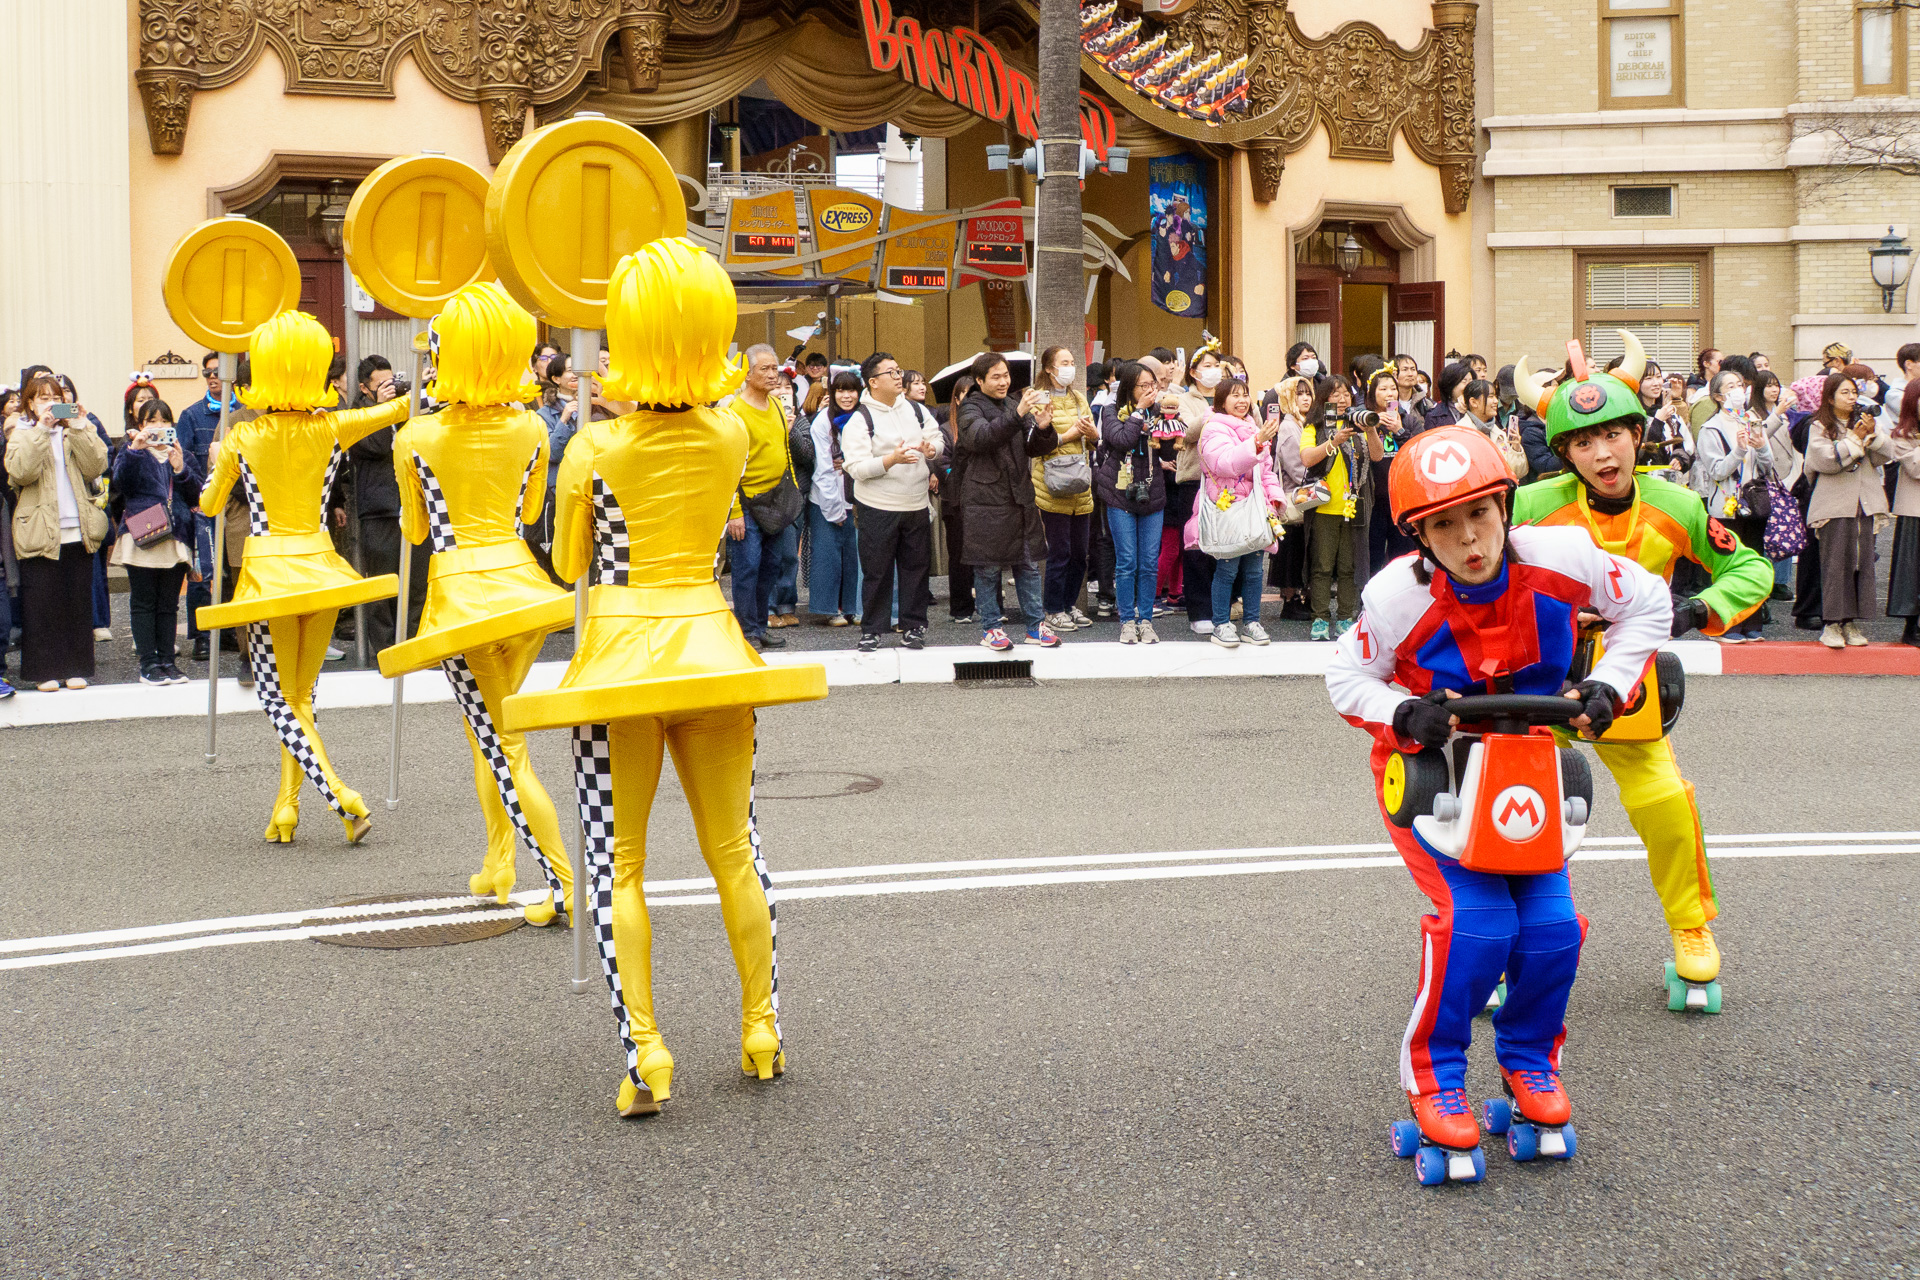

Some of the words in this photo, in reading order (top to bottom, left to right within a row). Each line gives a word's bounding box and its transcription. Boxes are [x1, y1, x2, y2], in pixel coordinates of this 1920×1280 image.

[1624, 32, 1656, 40] EDITOR
[1617, 61, 1665, 71] DEBORAH
[1615, 71, 1667, 81] BRINKLEY
[860, 0, 1117, 178] BACKDRP
[750, 206, 778, 218] SINGLES
[739, 219, 790, 229] シングルライダー
[825, 210, 869, 229] EXPRESS
[976, 220, 1018, 232] BACKDROP
[896, 236, 950, 249] HOLLYWOOD
[976, 233, 1016, 241] バックドロップ
[1427, 445, 1467, 475] M
[1498, 795, 1540, 828] M
